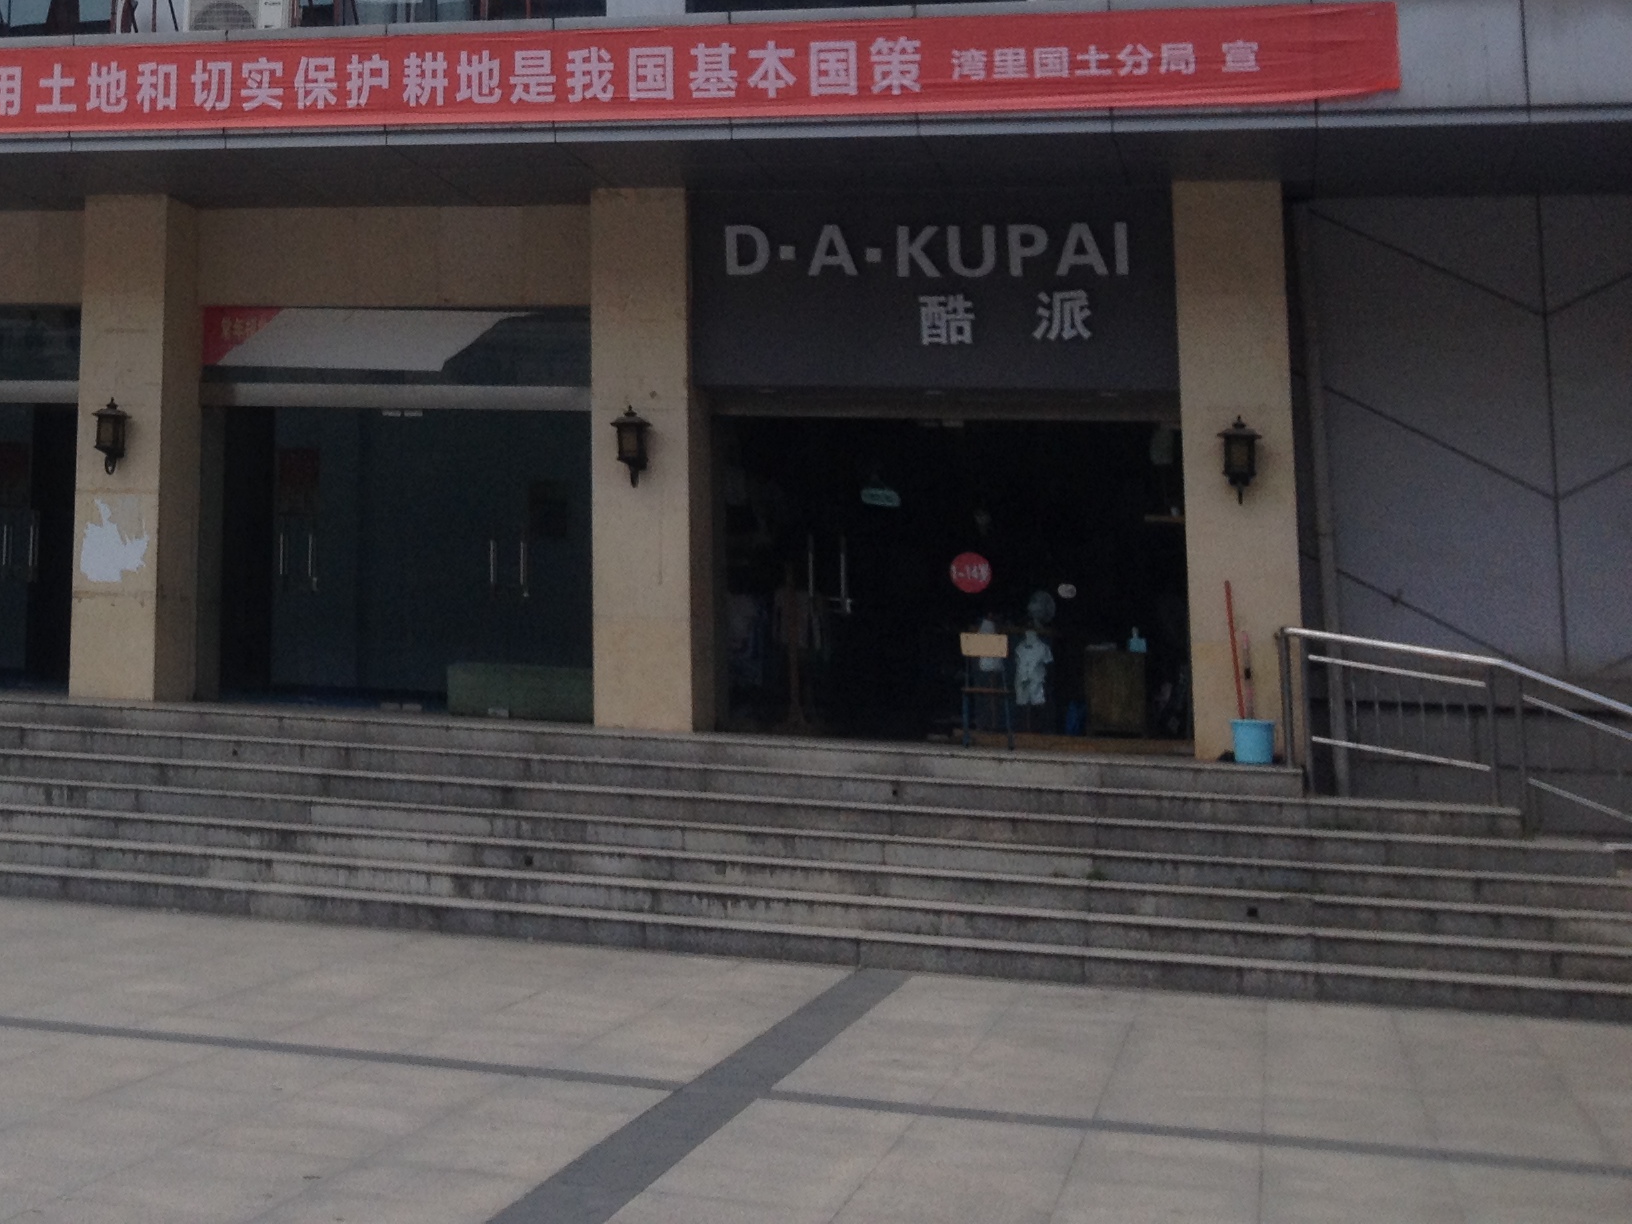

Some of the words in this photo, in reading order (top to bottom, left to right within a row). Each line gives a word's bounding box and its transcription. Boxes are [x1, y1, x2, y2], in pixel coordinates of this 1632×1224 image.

[950, 41, 1196, 81] 湾里国土分局
[1220, 40, 1260, 74] 宣
[917, 289, 1093, 346] 酷派
